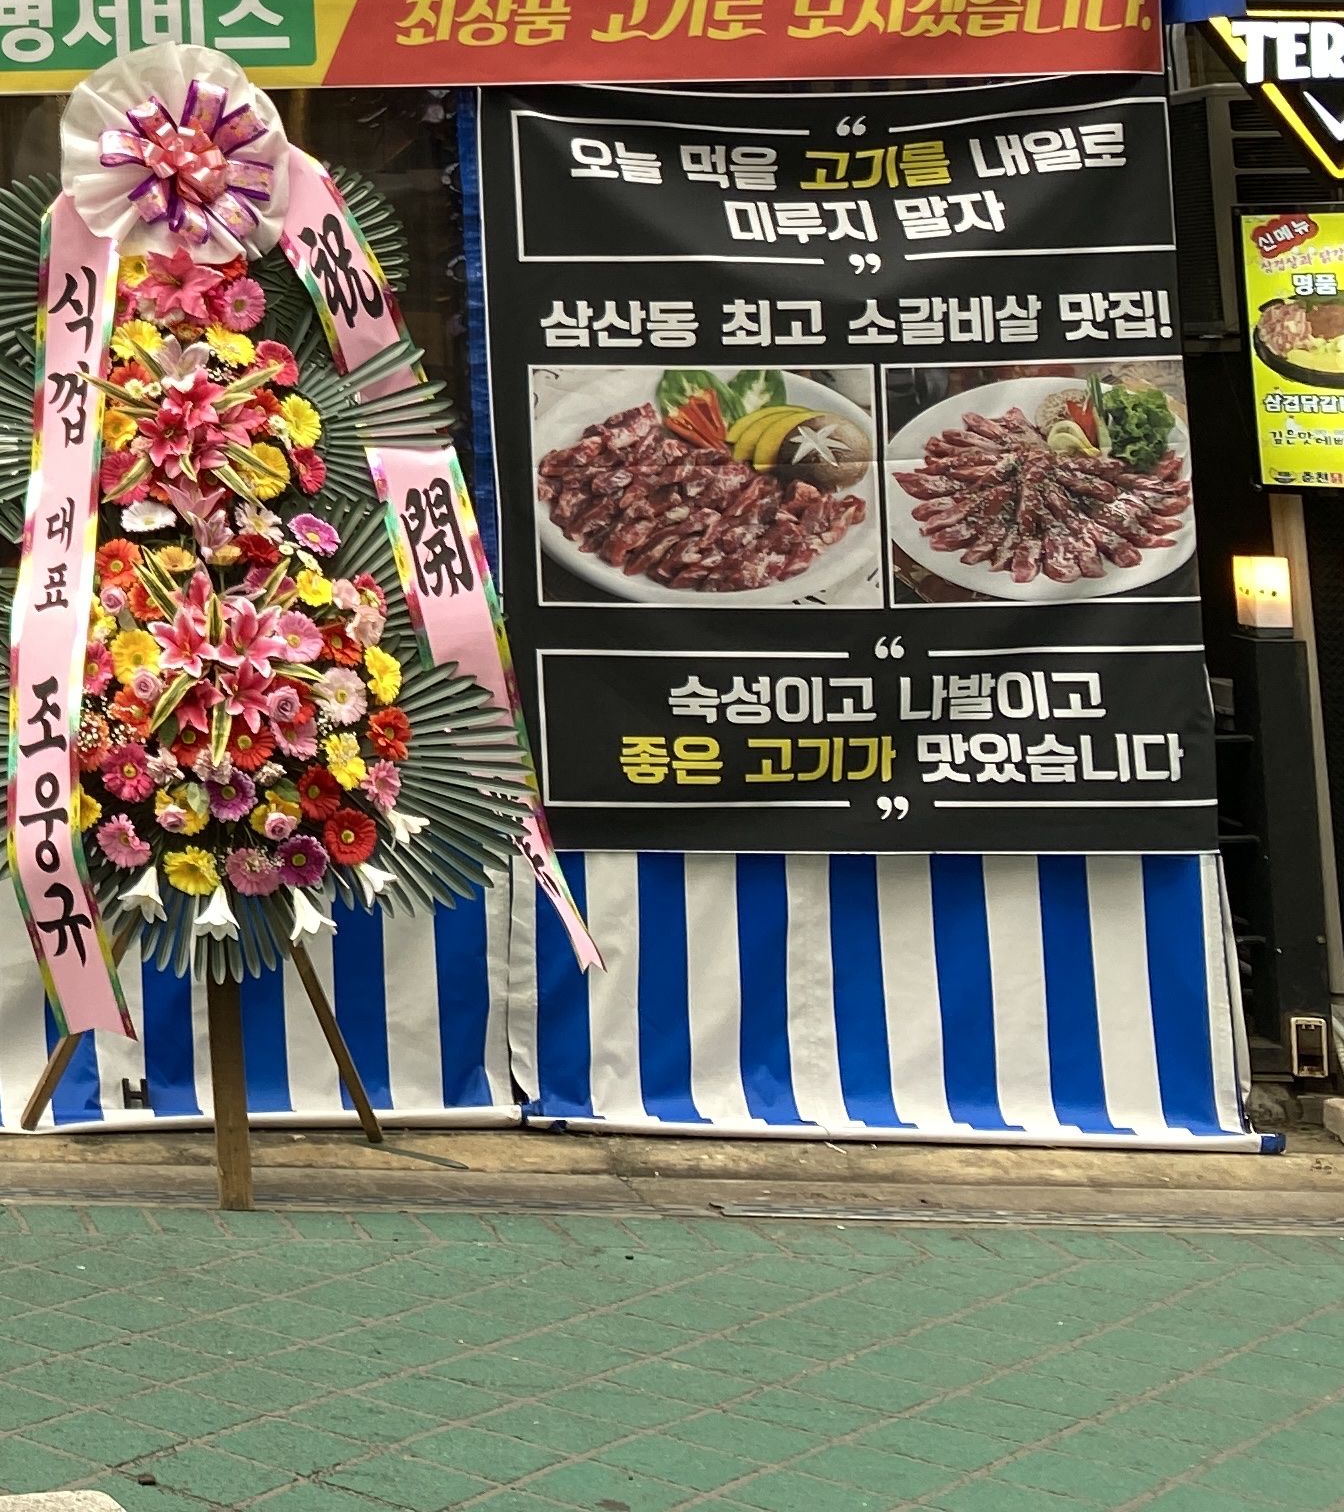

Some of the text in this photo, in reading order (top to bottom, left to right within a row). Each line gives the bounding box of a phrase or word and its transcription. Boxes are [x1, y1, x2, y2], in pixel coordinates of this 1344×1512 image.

[569, 123, 1127, 190] 오늘 먹을 고기를 내일로
[722, 191, 1006, 245] 미루지 말자
[1258, 220, 1310, 252] 신메뉴
[1291, 273, 1337, 296] 명품
[539, 291, 1174, 348] 삼산동 최고 소갈비살 맛집!
[308, 212, 476, 599] 祝 開
[34, 495, 76, 613] 대표
[668, 671, 1107, 723] 숙성이고 나발이고
[619, 732, 1184, 785] 좋은 고기가 맛있습니다
[17, 678, 94, 967] 조웅규
